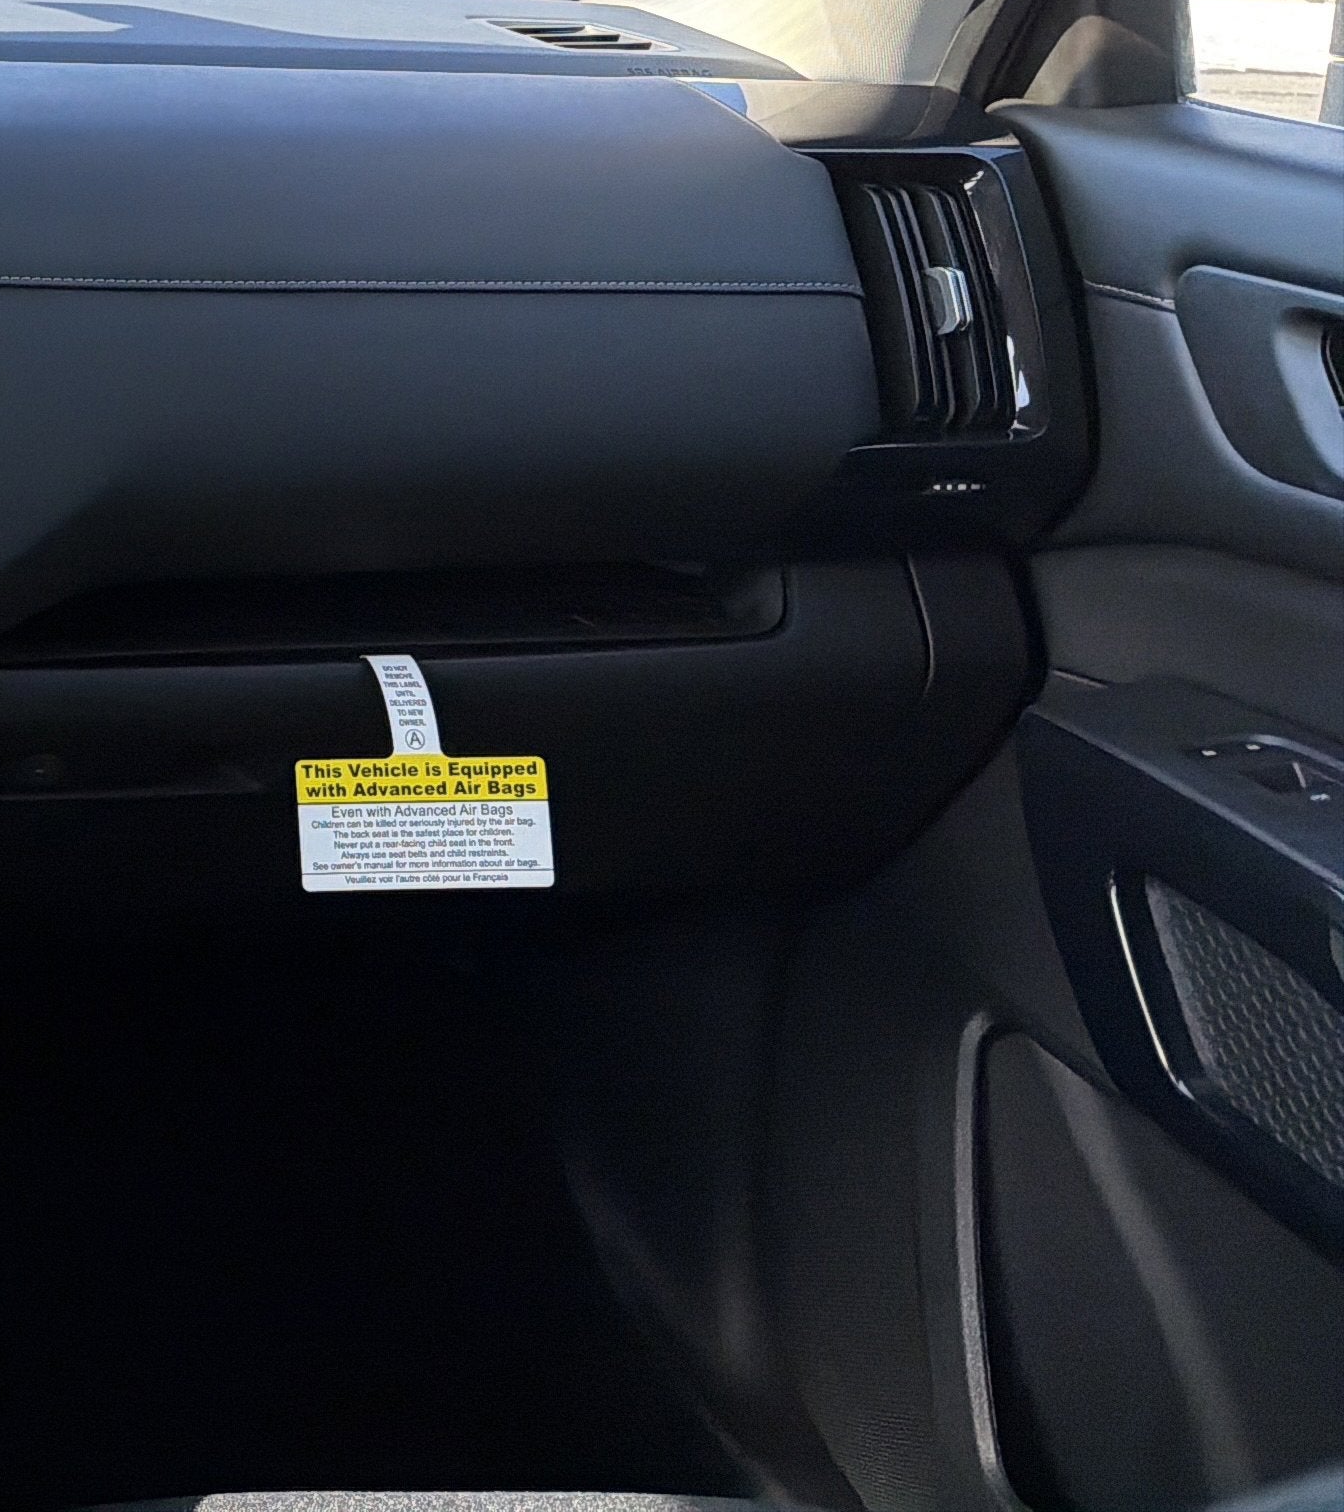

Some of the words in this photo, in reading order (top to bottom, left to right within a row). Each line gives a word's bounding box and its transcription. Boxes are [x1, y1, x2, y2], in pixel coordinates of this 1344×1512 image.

[301, 764, 342, 778] This
[347, 763, 419, 777] Vehicle
[425, 762, 442, 776] is
[448, 761, 537, 779] Equipped
[306, 783, 347, 797] with
[353, 781, 447, 796] Advanced
[454, 781, 481, 795] Air
[488, 781, 536, 797] Bags
[332, 806, 362, 818] Even
[366, 805, 391, 817] with
[394, 805, 456, 817] Advanced
[460, 804, 477, 816] Air
[481, 804, 513, 818] Bags
[312, 820, 344, 829] Children
[376, 819, 396, 827] killed
[409, 818, 445, 828] seriously
[447, 818, 475, 828] injured
[477, 817, 487, 827] by
[517, 817, 536, 827] bag.
[351, 830, 370, 838] back
[416, 829, 440, 837] safest
[442, 829, 464, 838] place
[466, 828, 477, 836] for
[479, 828, 514, 836] children.
[334, 841, 357, 849] Never
[360, 841, 373, 850] put
[383, 840, 425, 849] rear-facing
[428, 839, 447, 847] child
[449, 839, 466, 847] seat
[494, 838, 515, 846] front.
[312, 862, 329, 871] See
[331, 862, 362, 870] owner's
[364, 861, 393, 869] manual
[409, 860, 429, 868] more
[432, 859, 477, 868] information
[479, 858, 502, 867] about
[505, 858, 515, 866] air
[517, 859, 540, 868] bags.
